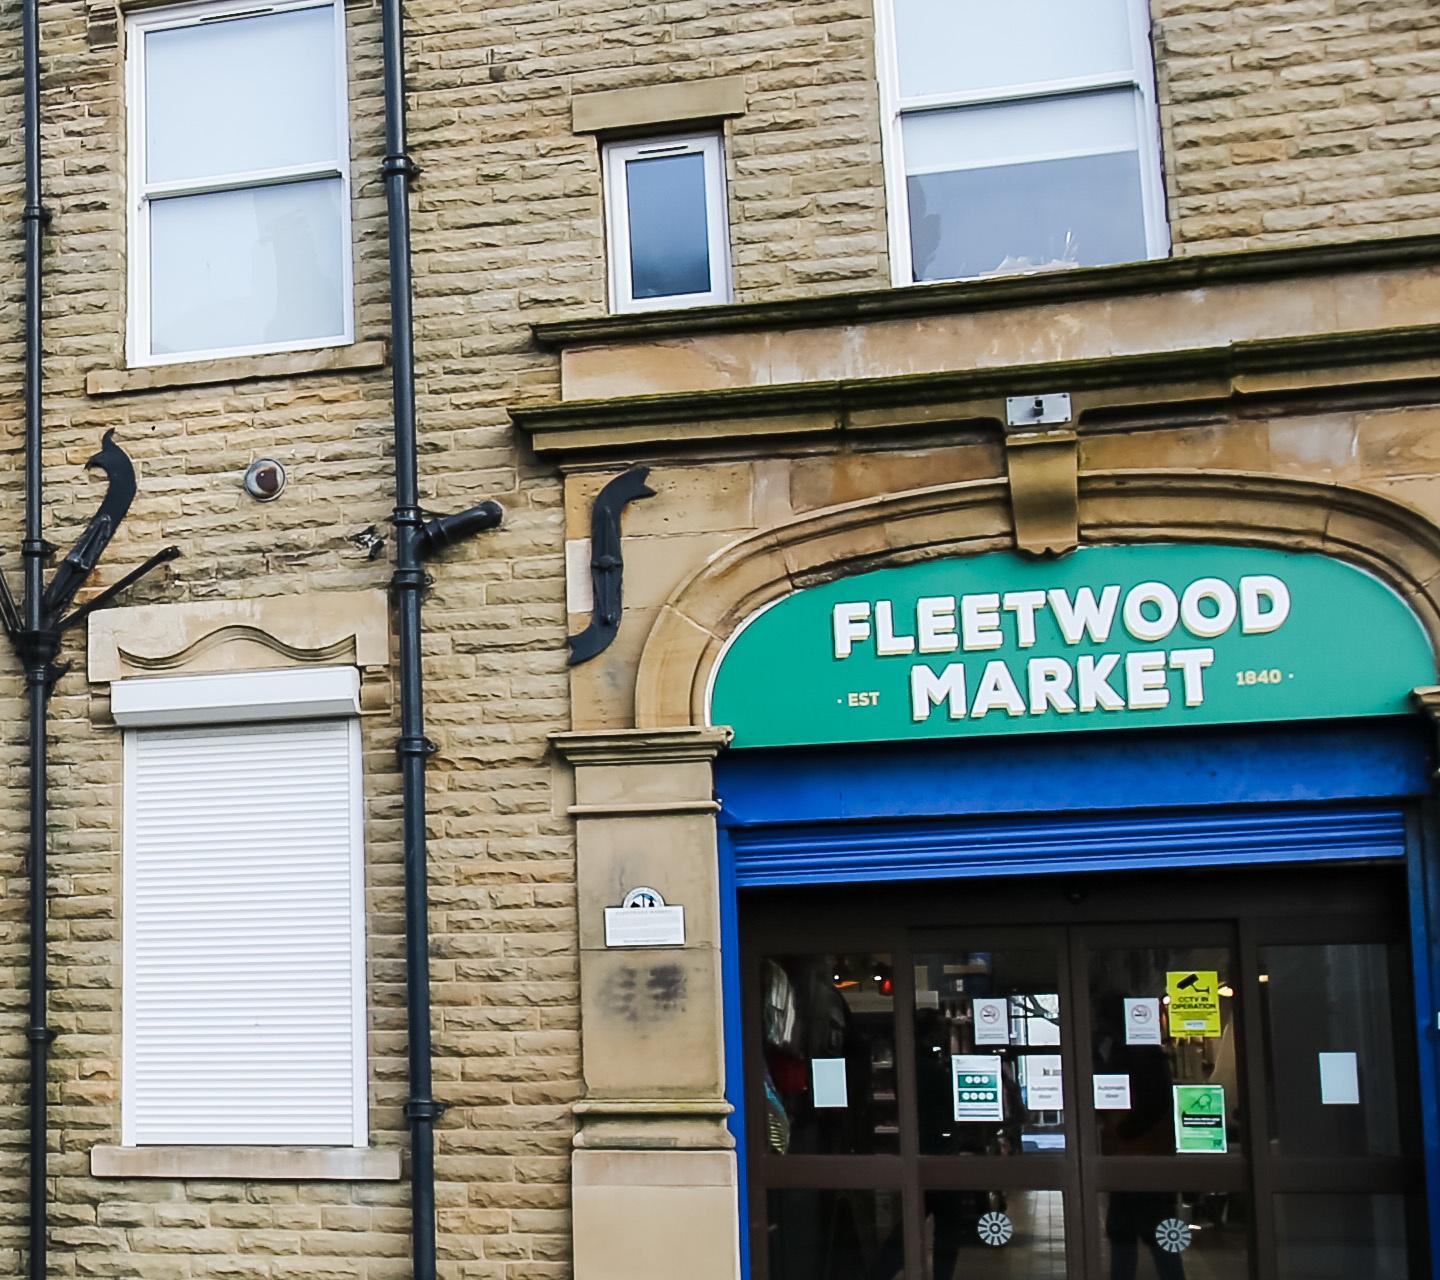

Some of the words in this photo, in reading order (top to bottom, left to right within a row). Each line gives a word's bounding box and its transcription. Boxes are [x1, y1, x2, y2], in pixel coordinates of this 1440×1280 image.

[833, 575, 1290, 658] FLEETWOOD
[848, 692, 879, 707] EST
[911, 648, 1214, 721] MARKET
[1236, 669, 1282, 686] 1840
